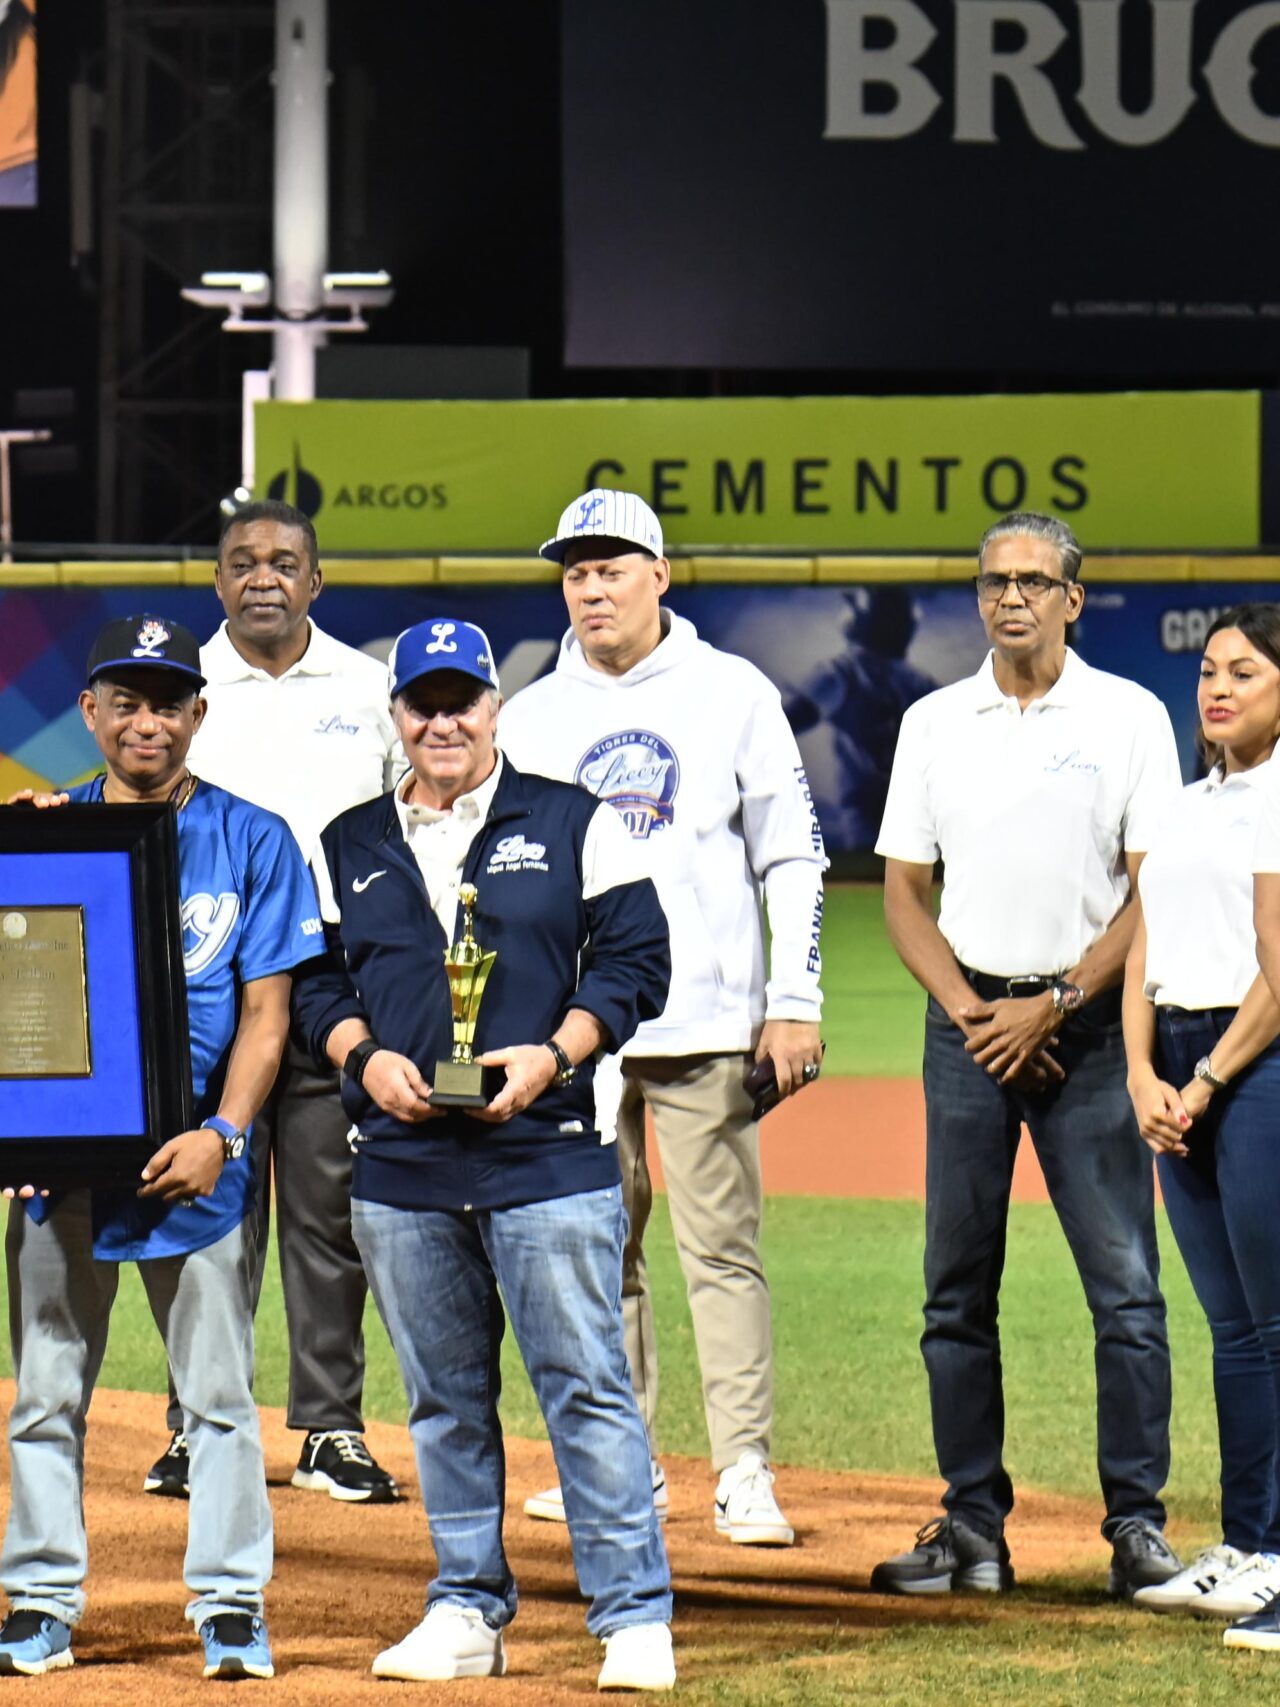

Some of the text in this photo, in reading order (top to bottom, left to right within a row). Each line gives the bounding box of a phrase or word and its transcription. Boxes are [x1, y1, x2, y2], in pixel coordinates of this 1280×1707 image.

[332, 483, 450, 511] ARGOS
[586, 455, 1089, 515] CEMENTOS
[426, 622, 458, 655] L
[639, 733, 660, 751] DEL
